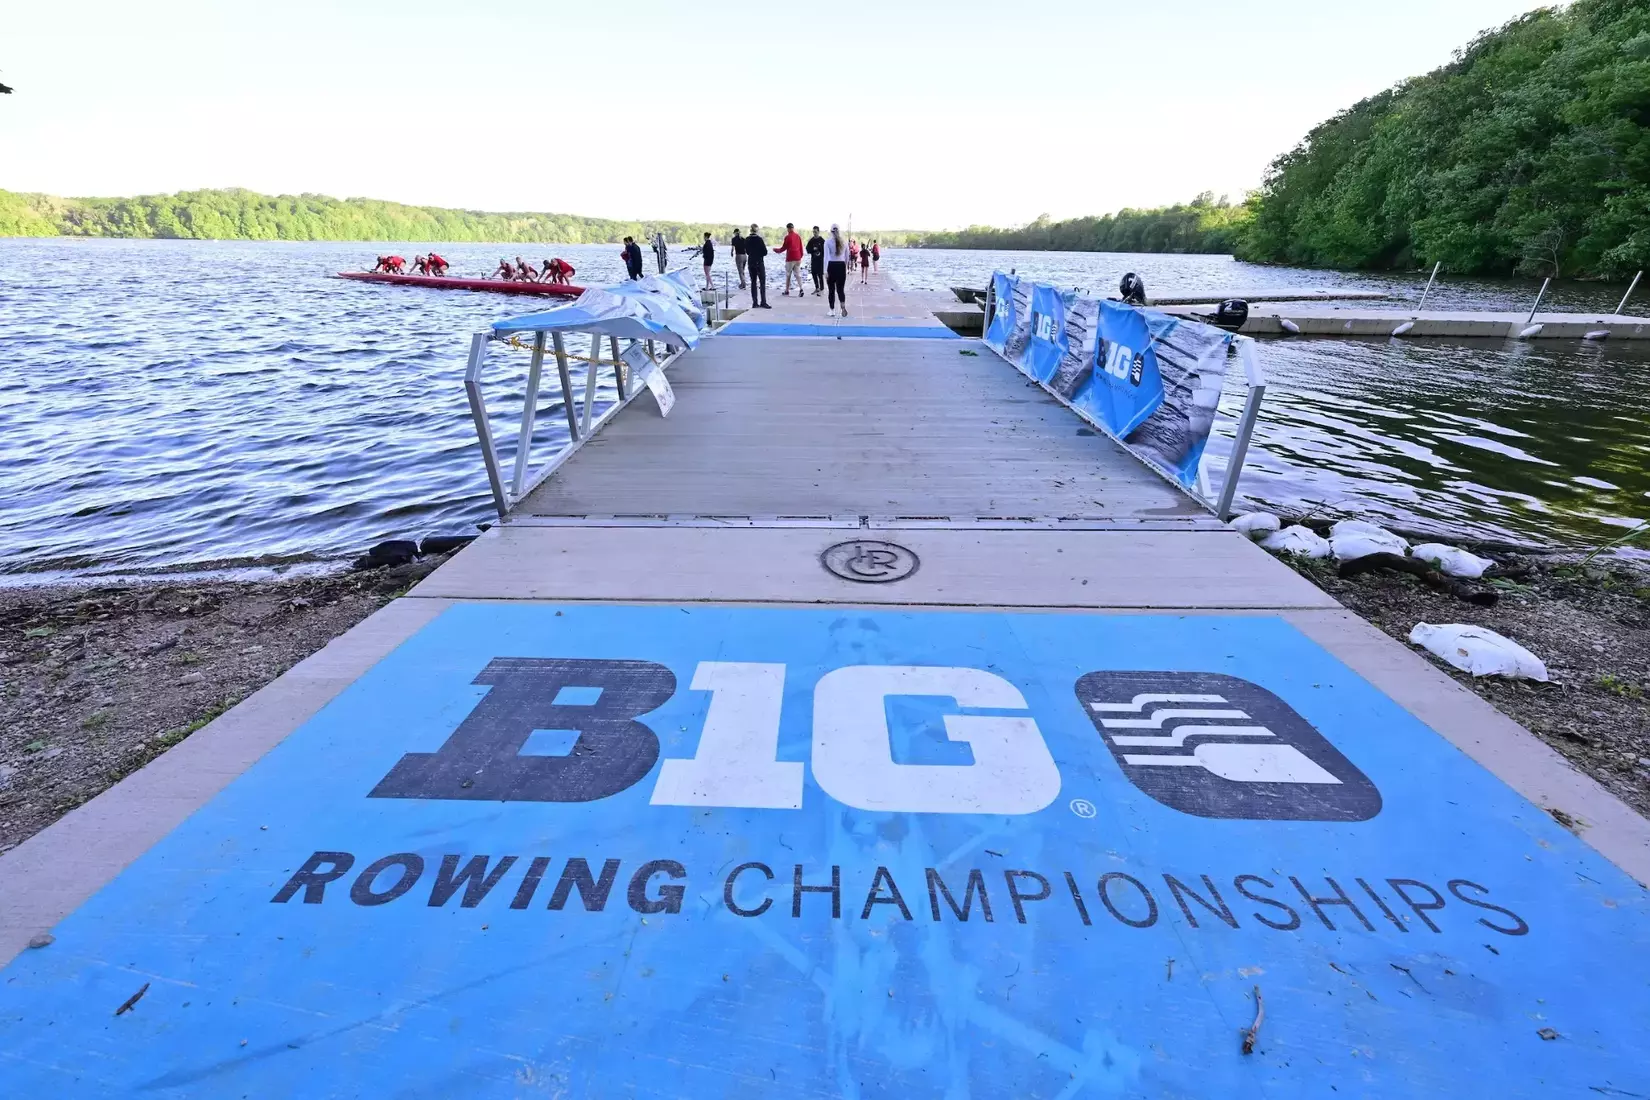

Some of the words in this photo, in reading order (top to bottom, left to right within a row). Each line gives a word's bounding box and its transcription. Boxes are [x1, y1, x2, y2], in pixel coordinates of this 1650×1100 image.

[1224, 301, 1233, 311] 2
[269, 850, 687, 915] ROWING
[723, 861, 1529, 936] CHAMPIONSHIPS
